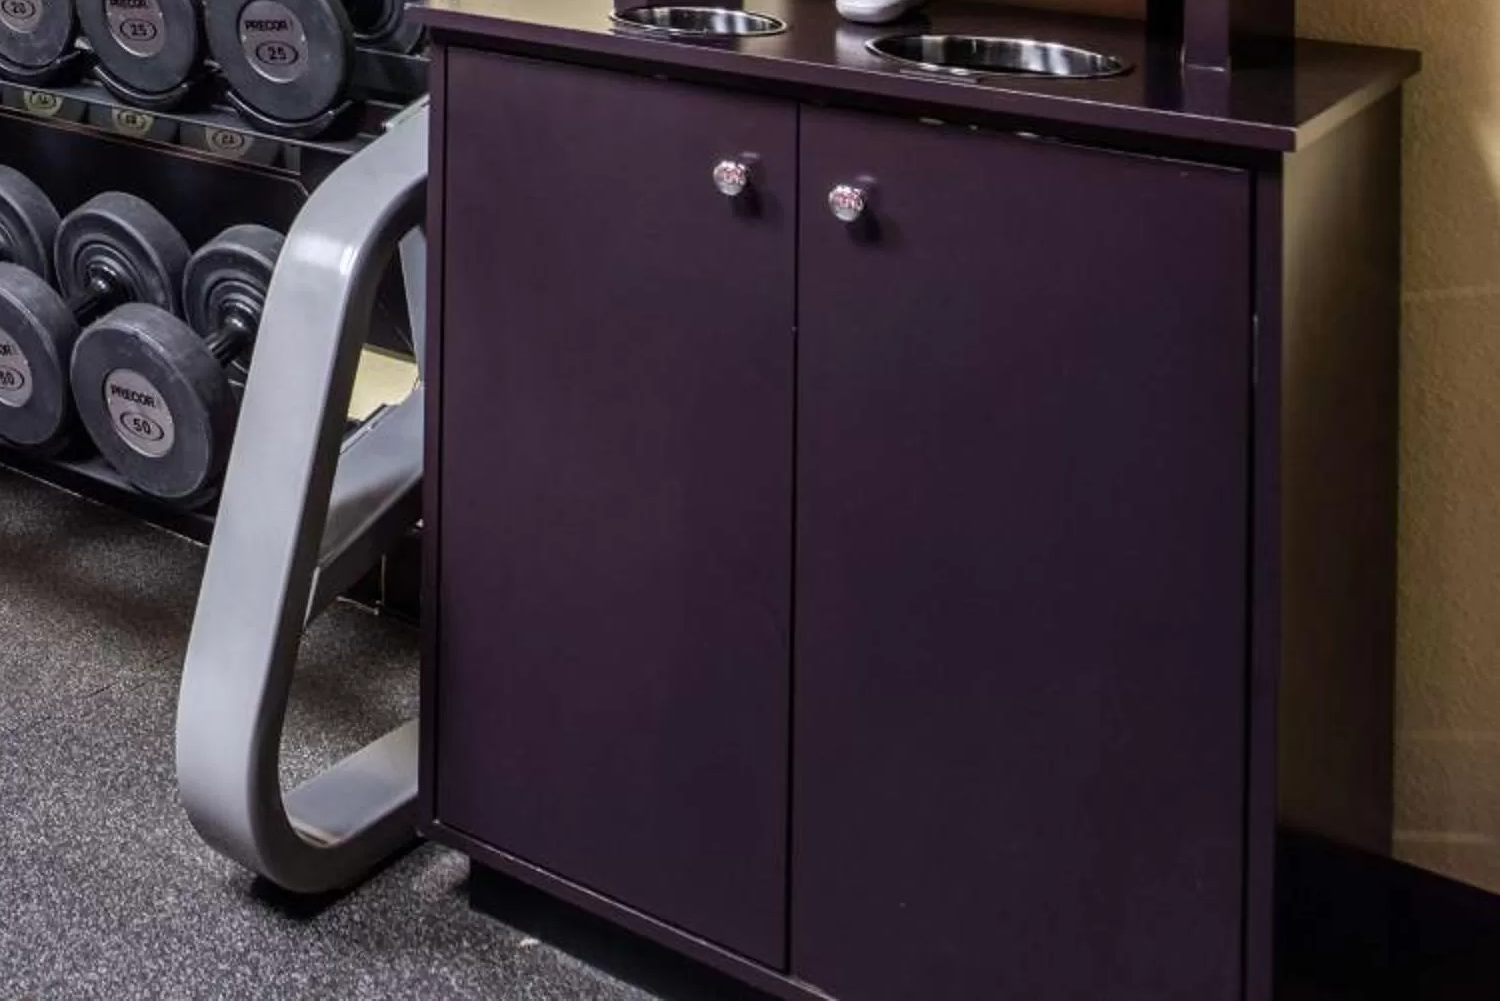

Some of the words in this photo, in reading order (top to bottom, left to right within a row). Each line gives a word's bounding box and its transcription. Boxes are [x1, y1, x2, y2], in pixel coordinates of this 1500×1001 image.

[245, 20, 288, 32] PRECOR
[267, 46, 287, 60] 25
[110, 384, 155, 408] PRECOR
[133, 418, 151, 435] 50
